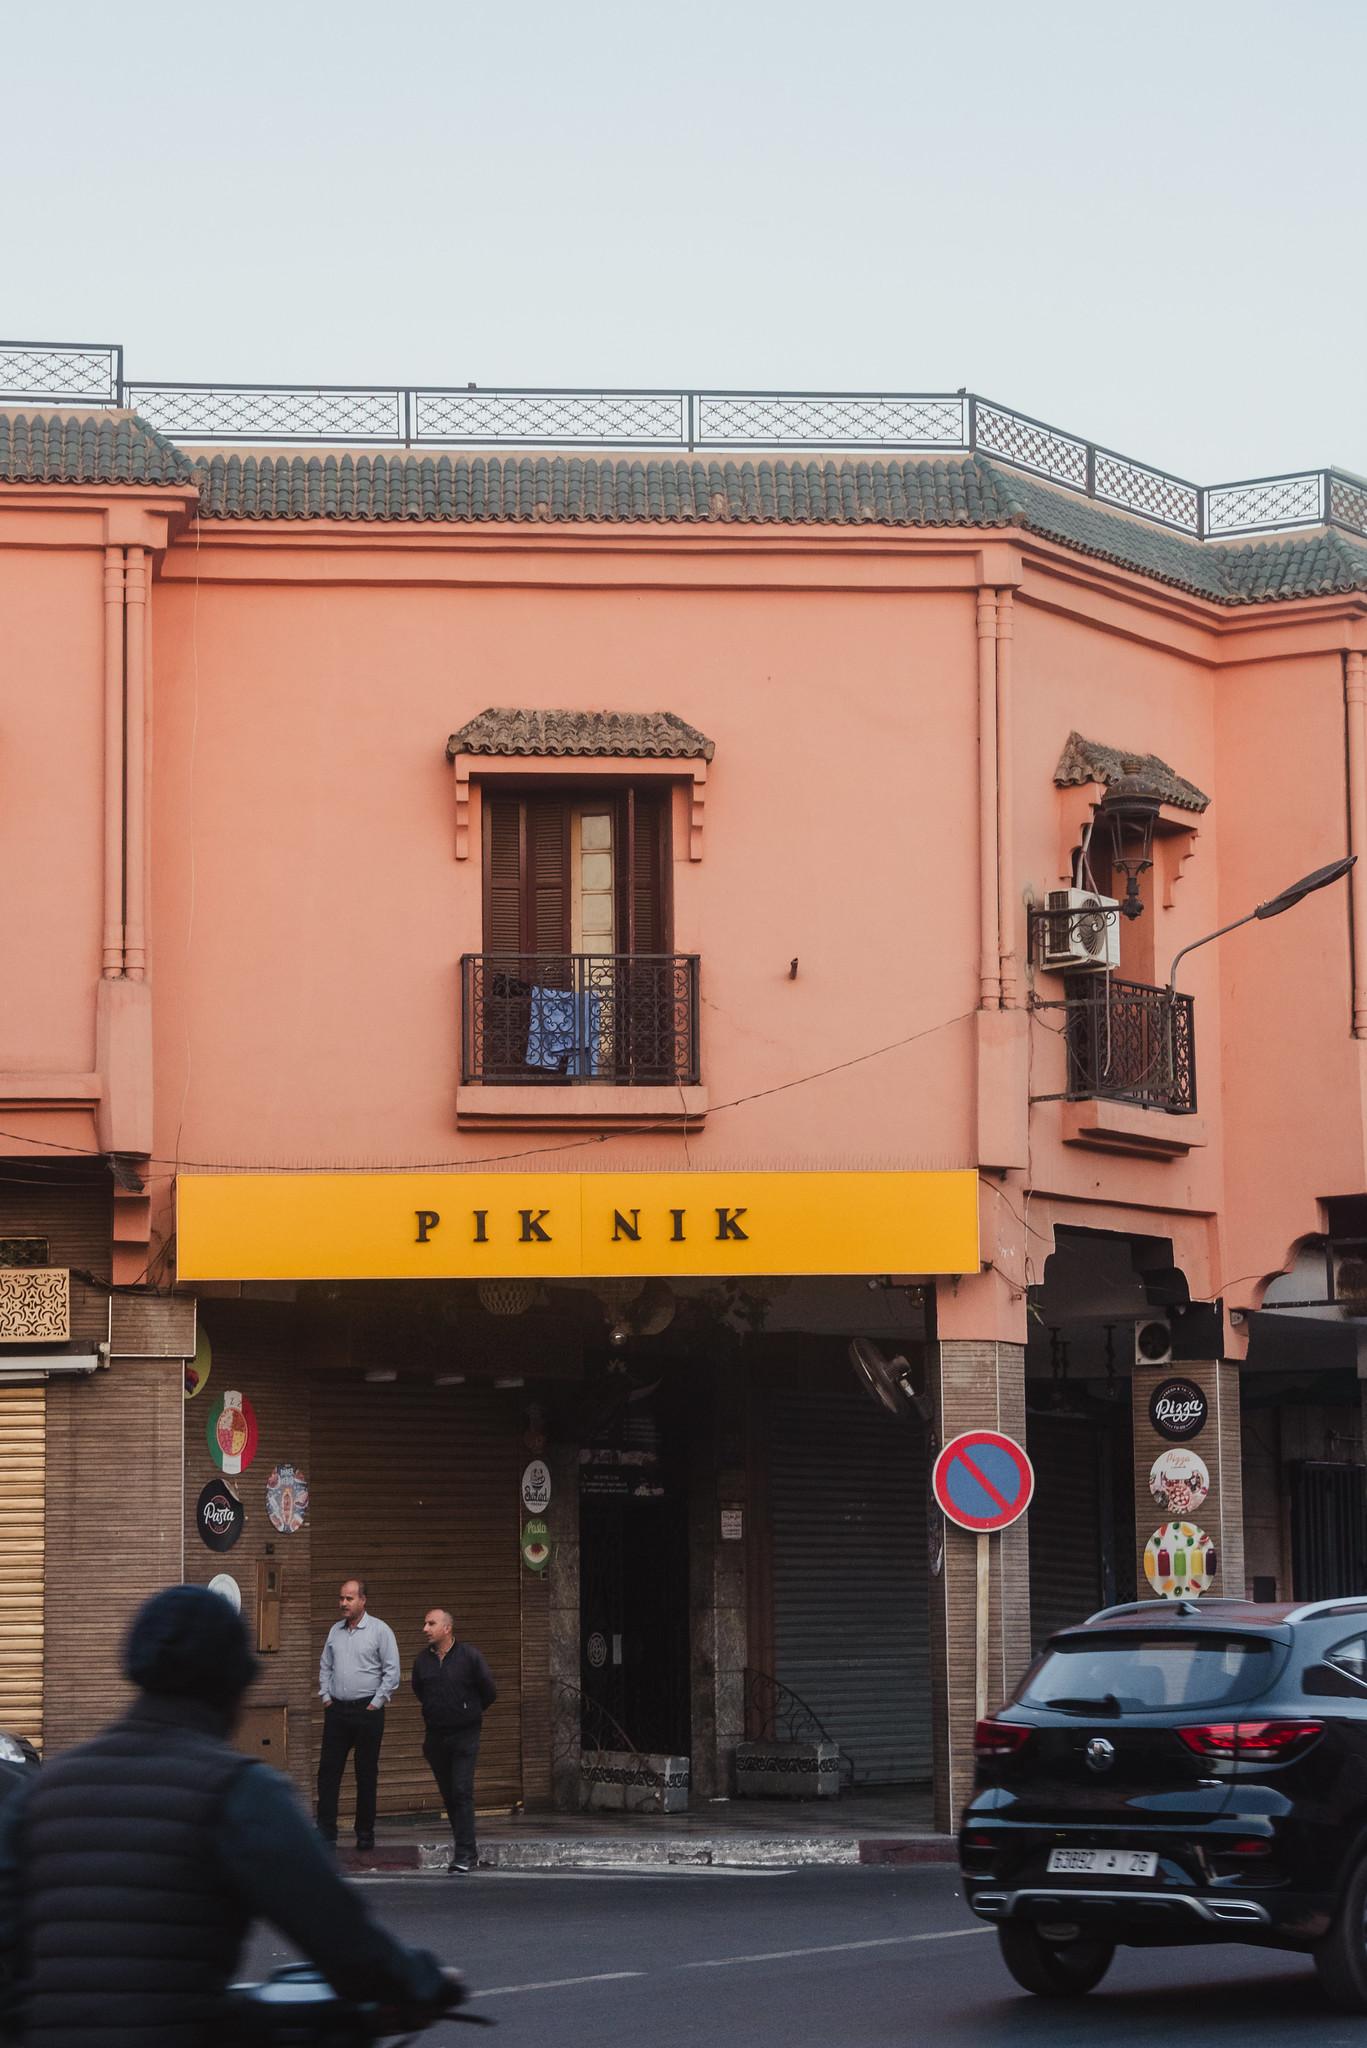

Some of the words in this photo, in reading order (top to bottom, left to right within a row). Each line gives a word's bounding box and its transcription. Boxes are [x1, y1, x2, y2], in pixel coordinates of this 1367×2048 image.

[1155, 1398, 1203, 1422] Pizza
[1166, 1452, 1191, 1467] Pizza
[203, 1502, 236, 1525] Pasta
[527, 1521, 547, 1534] Pasta
